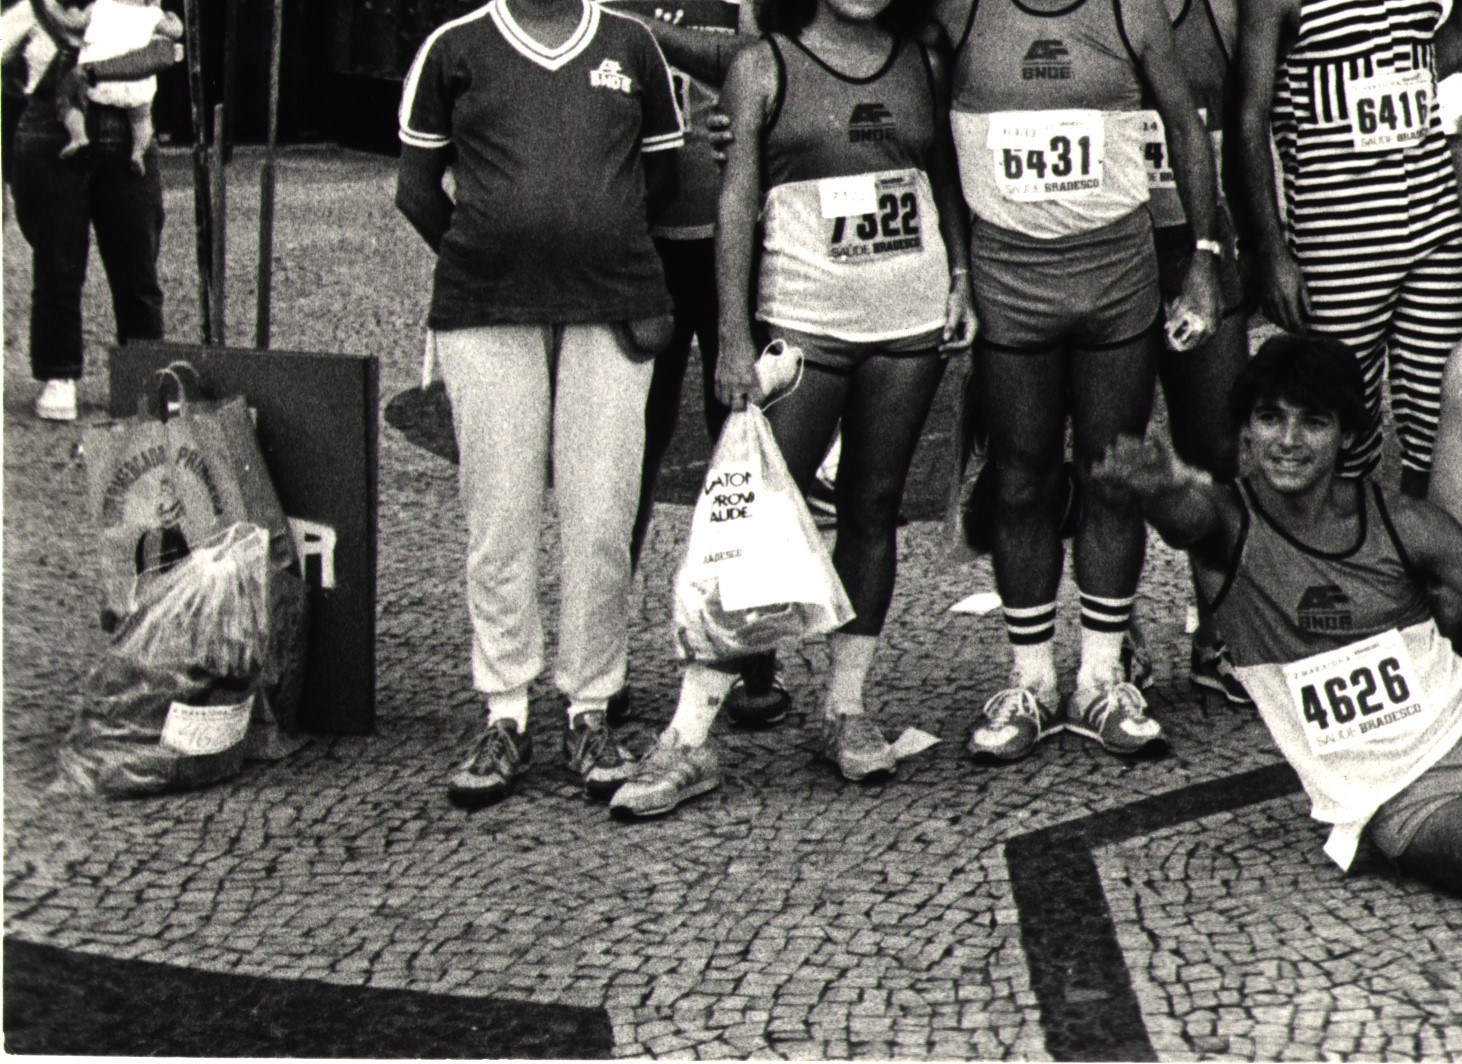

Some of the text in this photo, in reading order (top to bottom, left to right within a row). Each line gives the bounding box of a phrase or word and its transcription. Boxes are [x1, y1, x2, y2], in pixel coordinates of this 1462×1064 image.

[1021, 66, 1071, 80] BNDE
[1356, 89, 1428, 135] 6416
[1002, 135, 1091, 180] 6431
[1044, 178, 1100, 193] BRADESCO
[1301, 657, 1410, 730] 4626
[1359, 702, 1423, 734] BRADESCO
